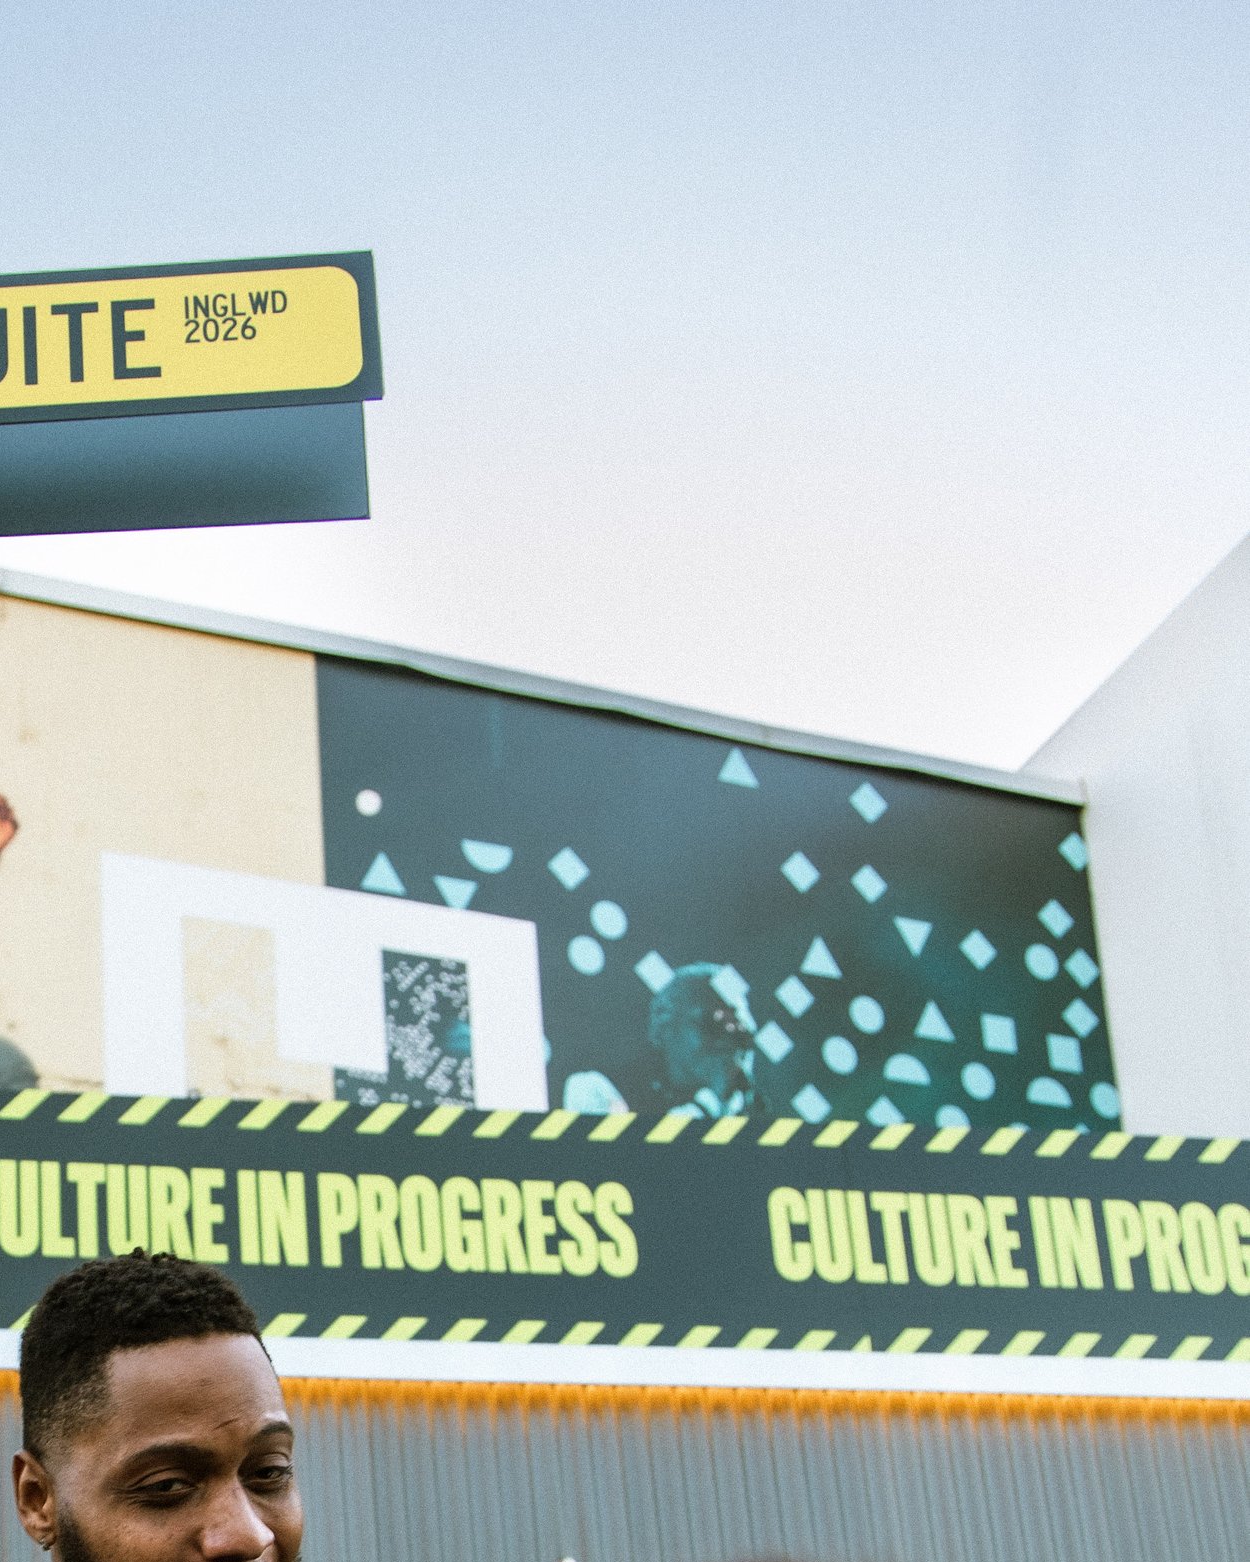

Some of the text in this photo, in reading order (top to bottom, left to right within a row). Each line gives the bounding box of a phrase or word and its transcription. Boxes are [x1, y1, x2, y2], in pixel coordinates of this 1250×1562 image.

[184, 290, 288, 320] INGLWD
[184, 316, 257, 344] 2026
[236, 1169, 309, 1267] IN
[317, 1173, 639, 1278] PROGRESS
[767, 1186, 1029, 1289] CULTURE
[1028, 1195, 1104, 1290] IN
